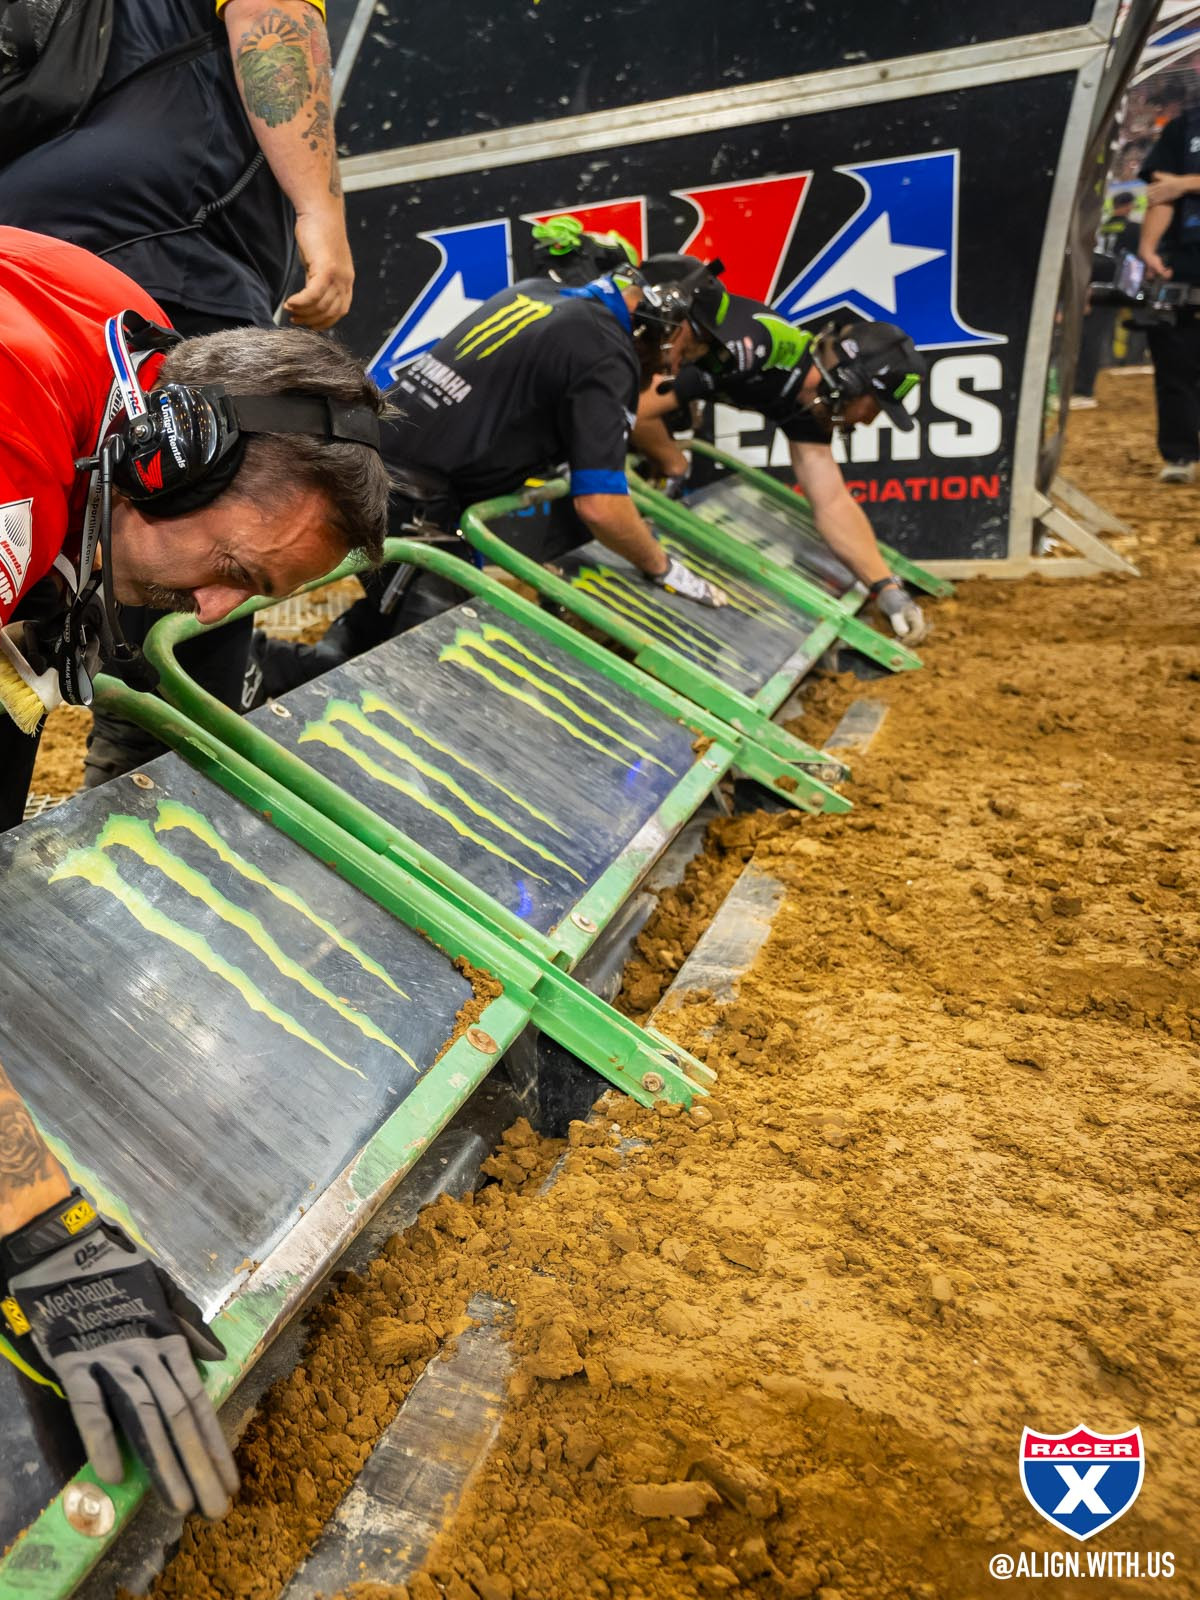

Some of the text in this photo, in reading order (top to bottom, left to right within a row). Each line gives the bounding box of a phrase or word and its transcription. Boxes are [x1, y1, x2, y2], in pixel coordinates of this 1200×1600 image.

[420, 358, 472, 403] YAMAHA
[161, 403, 186, 469] United Rentals
[785, 475, 1000, 504] CIATION
[0, 539, 22, 576] Honda
[34, 1278, 121, 1323] Mechanix
[66, 1298, 150, 1333] Mechanix
